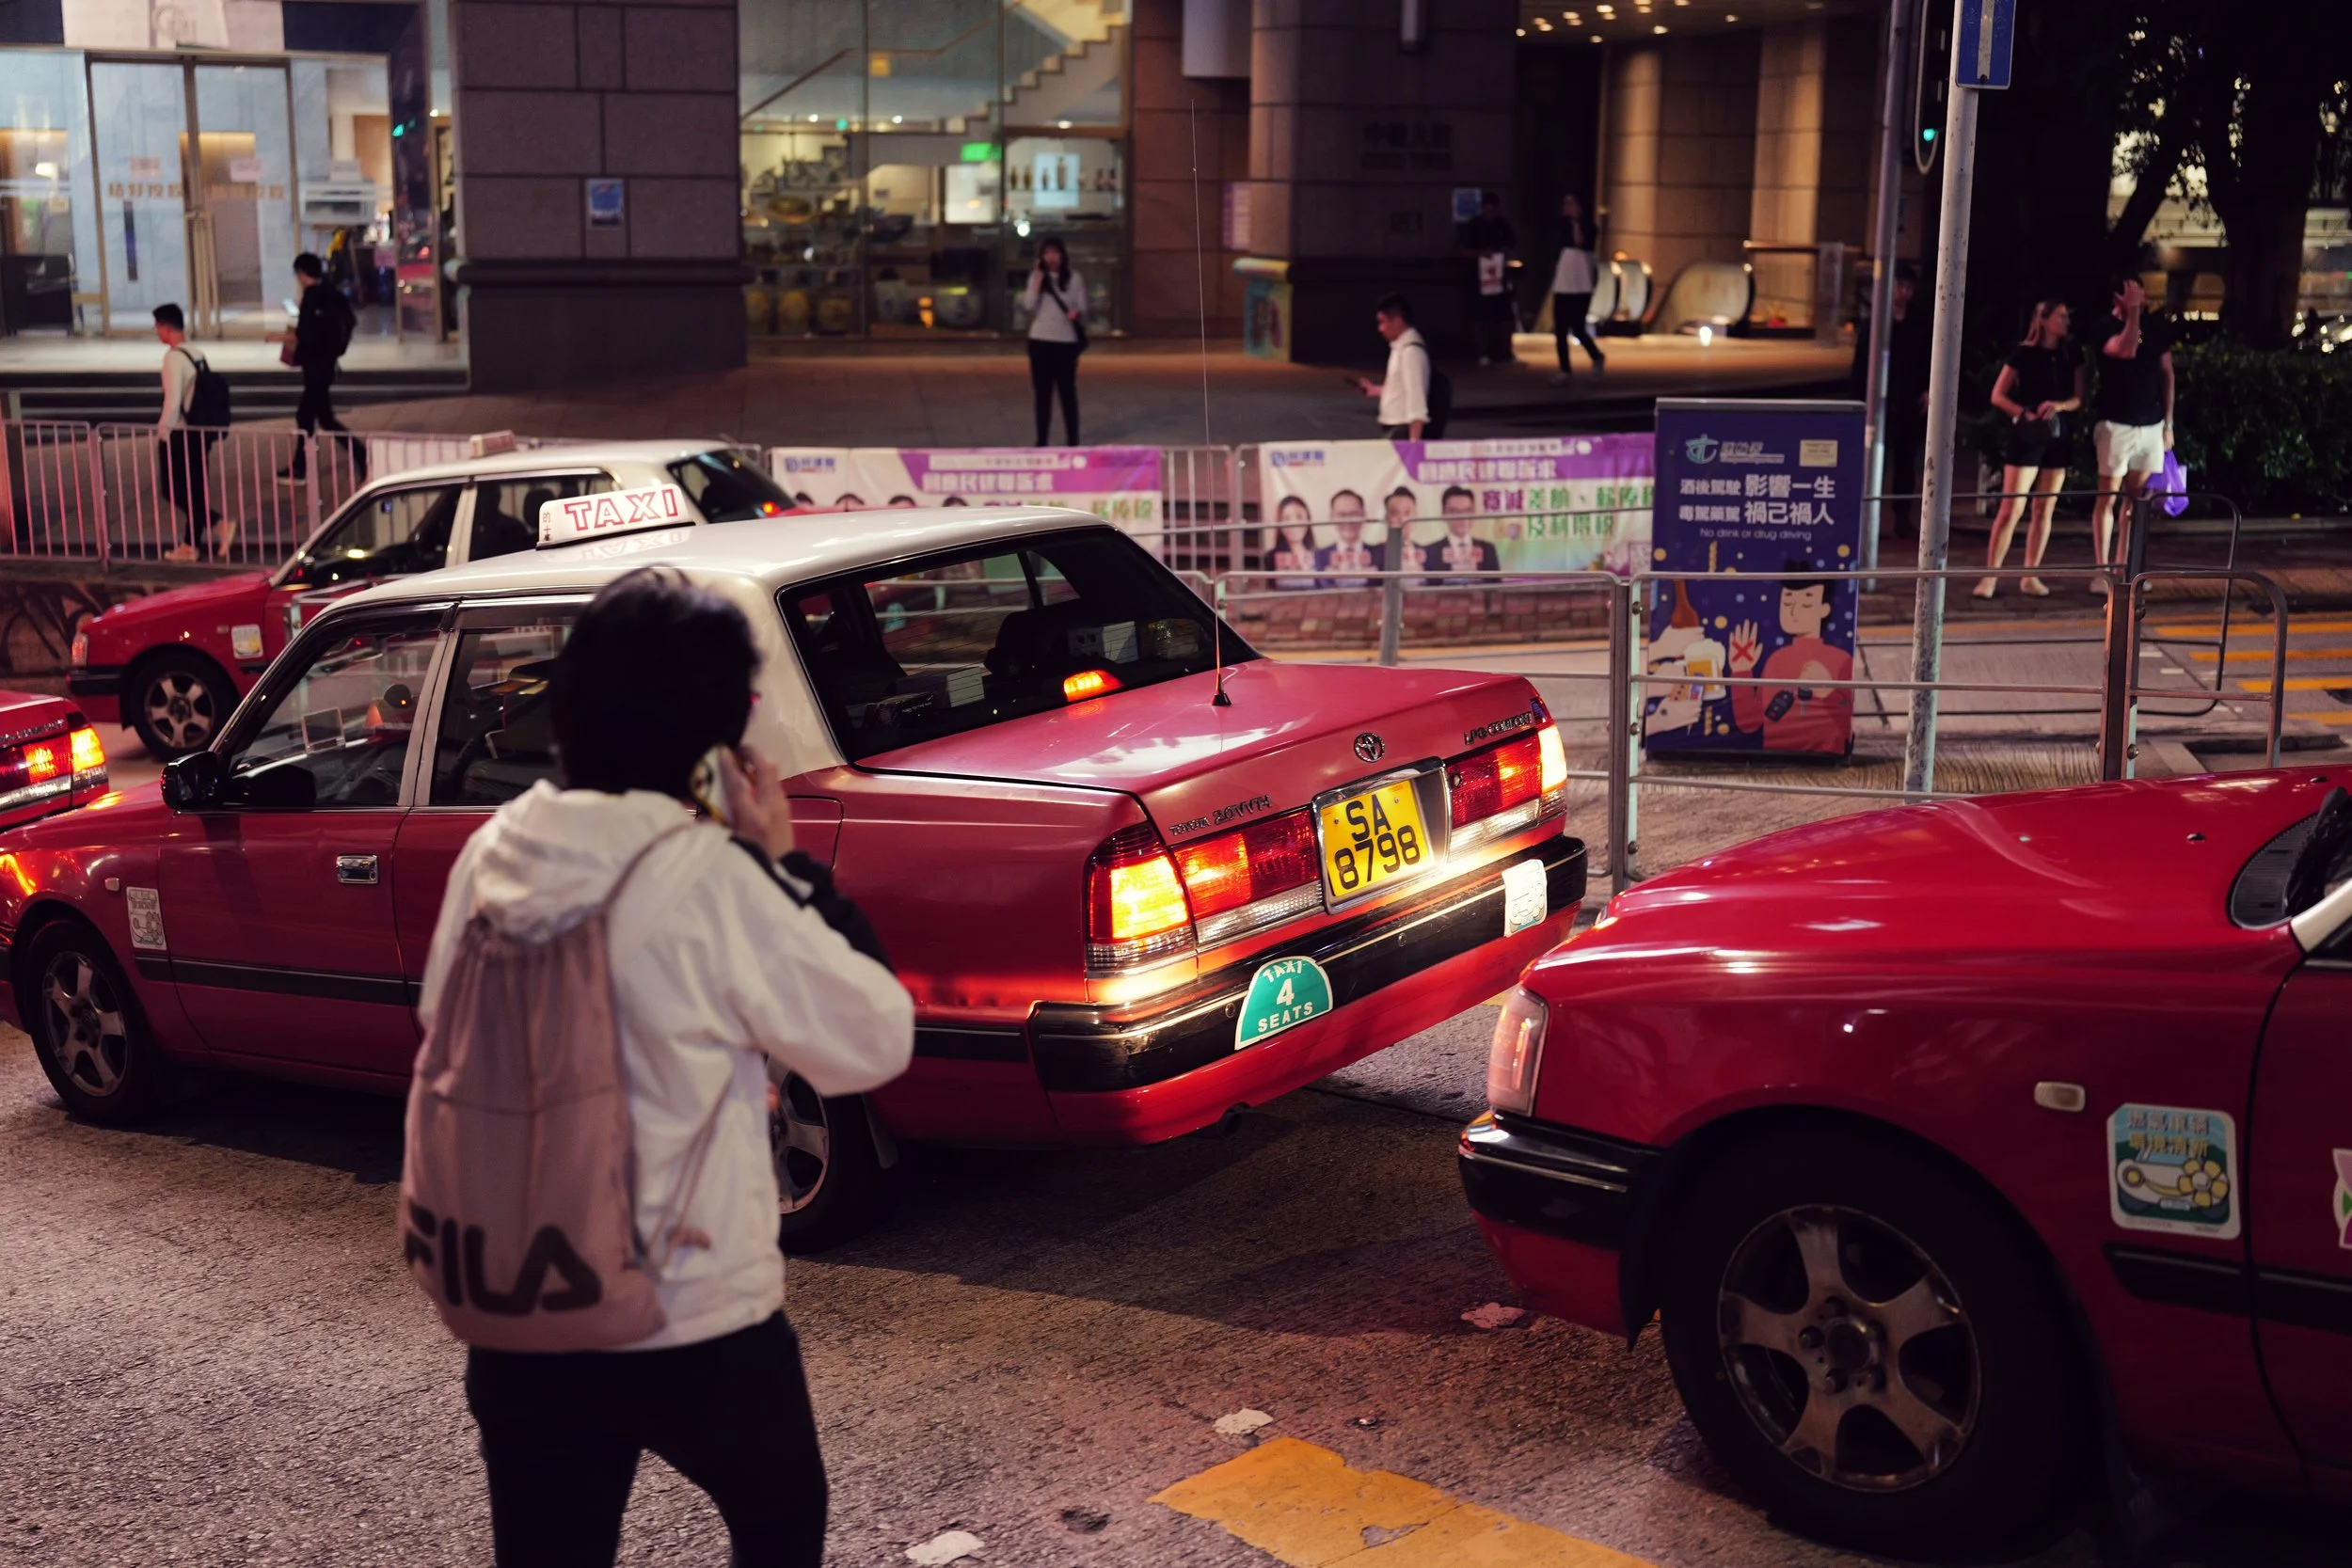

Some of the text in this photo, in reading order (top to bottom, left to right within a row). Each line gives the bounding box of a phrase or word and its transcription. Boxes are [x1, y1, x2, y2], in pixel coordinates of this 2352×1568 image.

[1680, 474, 1836, 499] 酒後駕駛 影響一生
[564, 488, 679, 531] TAXI
[1745, 501, 1834, 525] 禍己禍人
[1700, 528, 1714, 537] No
[1717, 528, 1739, 537] drink
[1755, 529, 1777, 540] drug
[1779, 530, 1811, 541] driving
[1168, 816, 1212, 836] TOYOTA
[1344, 793, 1392, 843] SA
[1334, 824, 1422, 891] 8798
[1262, 959, 1304, 983] TAXI
[1276, 977, 1295, 1007] 4
[1257, 1001, 1314, 1034] SEATS
[406, 1203, 600, 1315] FILA
